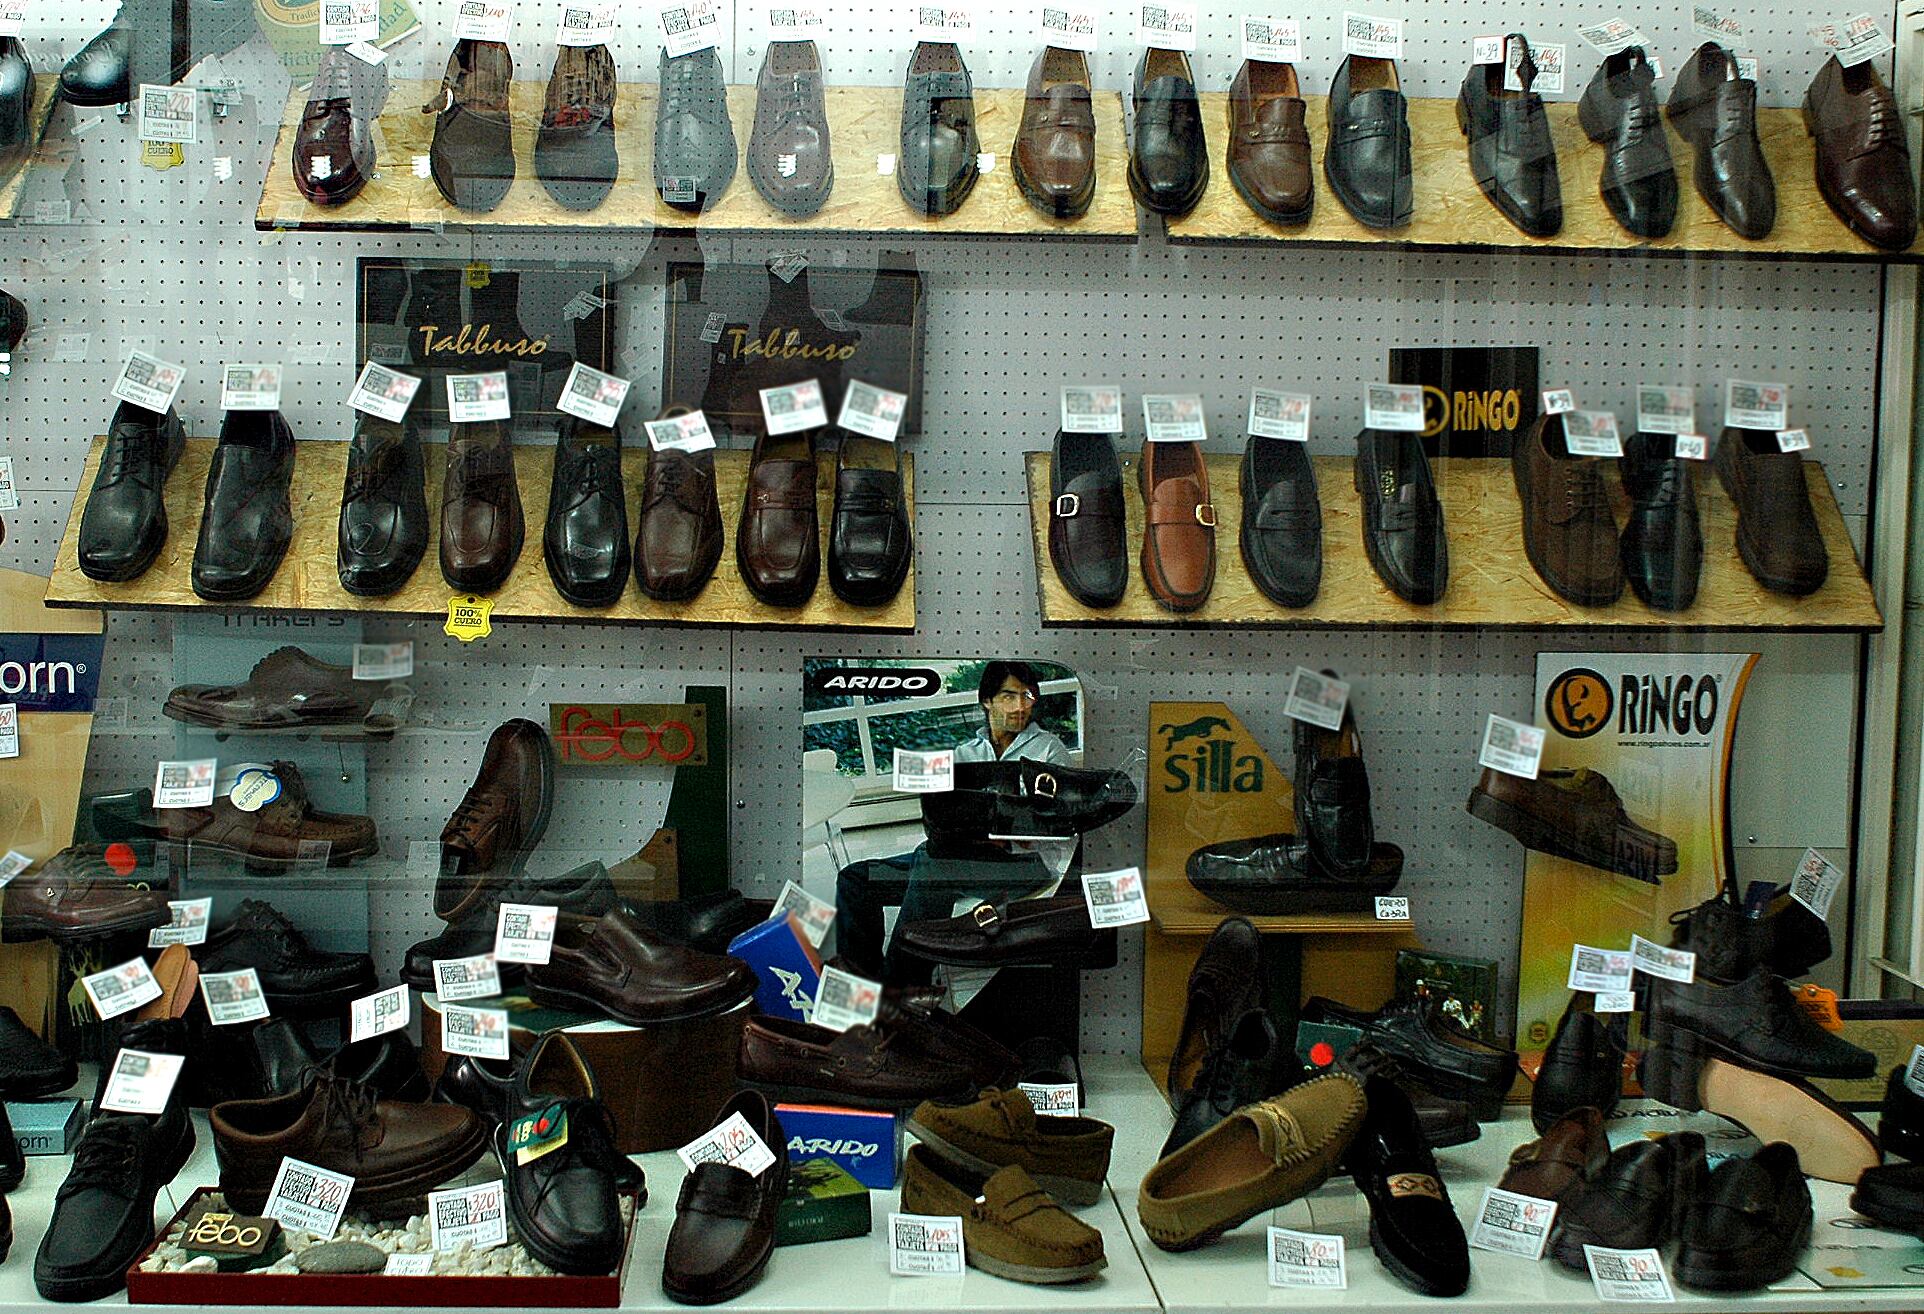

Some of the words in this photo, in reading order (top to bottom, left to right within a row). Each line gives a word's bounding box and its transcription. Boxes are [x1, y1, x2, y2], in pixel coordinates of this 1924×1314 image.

[419, 323, 548, 357] Tabbuso
[727, 327, 859, 361] Tabbuso
[454, 617, 483, 626] CUERO
[455, 608, 483, 617] 100%
[823, 675, 929, 690] ARIDO
[554, 705, 696, 762] febo
[1164, 739, 1264, 793] silla
[787, 1136, 879, 1157] ARIDO
[188, 1213, 261, 1246] febo
